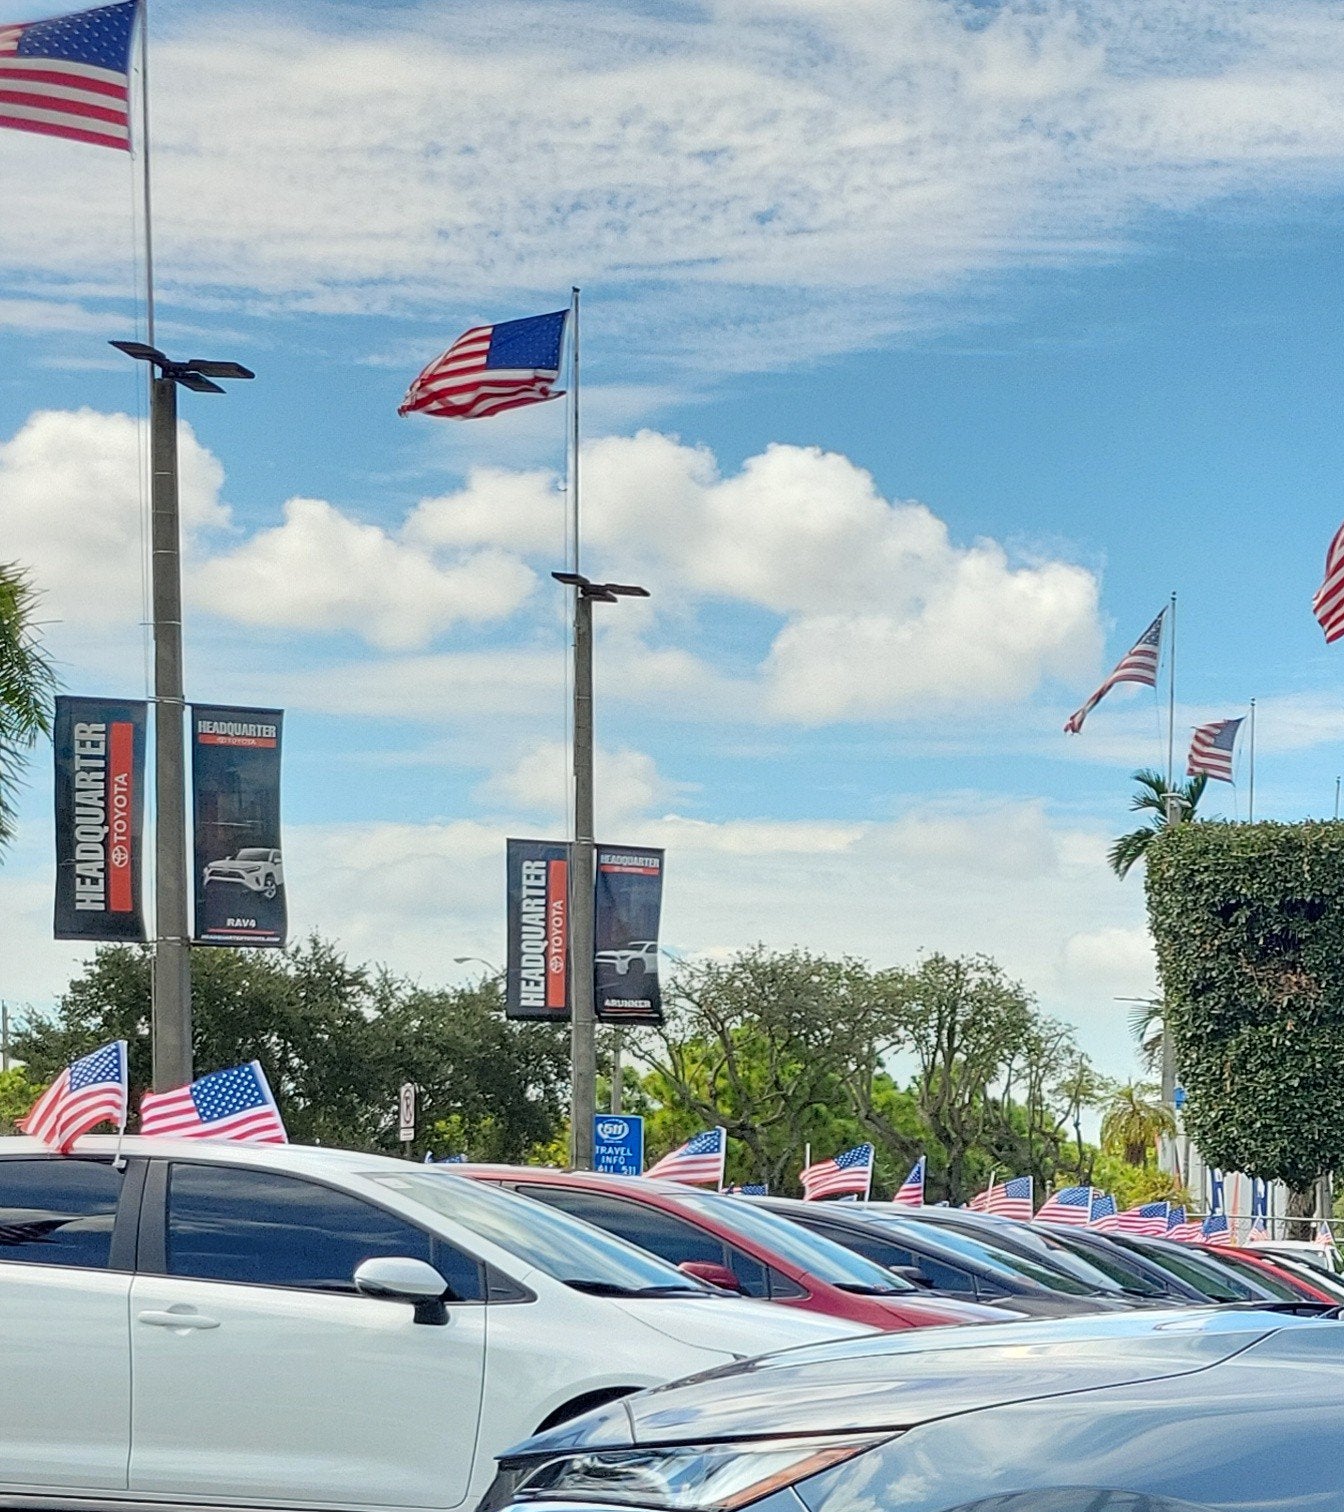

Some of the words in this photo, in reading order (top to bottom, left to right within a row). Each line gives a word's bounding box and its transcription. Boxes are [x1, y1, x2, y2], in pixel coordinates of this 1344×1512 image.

[198, 720, 276, 737] HEADQUARTER
[114, 773, 128, 841] TOYOTA
[74, 722, 109, 911] HEADQUARTER
[226, 918, 257, 928] RAV4
[552, 900, 564, 954] TOYOTA
[520, 860, 548, 1007] HEADQUARTER
[603, 1123, 625, 1135] 511
[595, 1146, 633, 1156] TRAVEL
[601, 1156, 626, 1165] INFO
